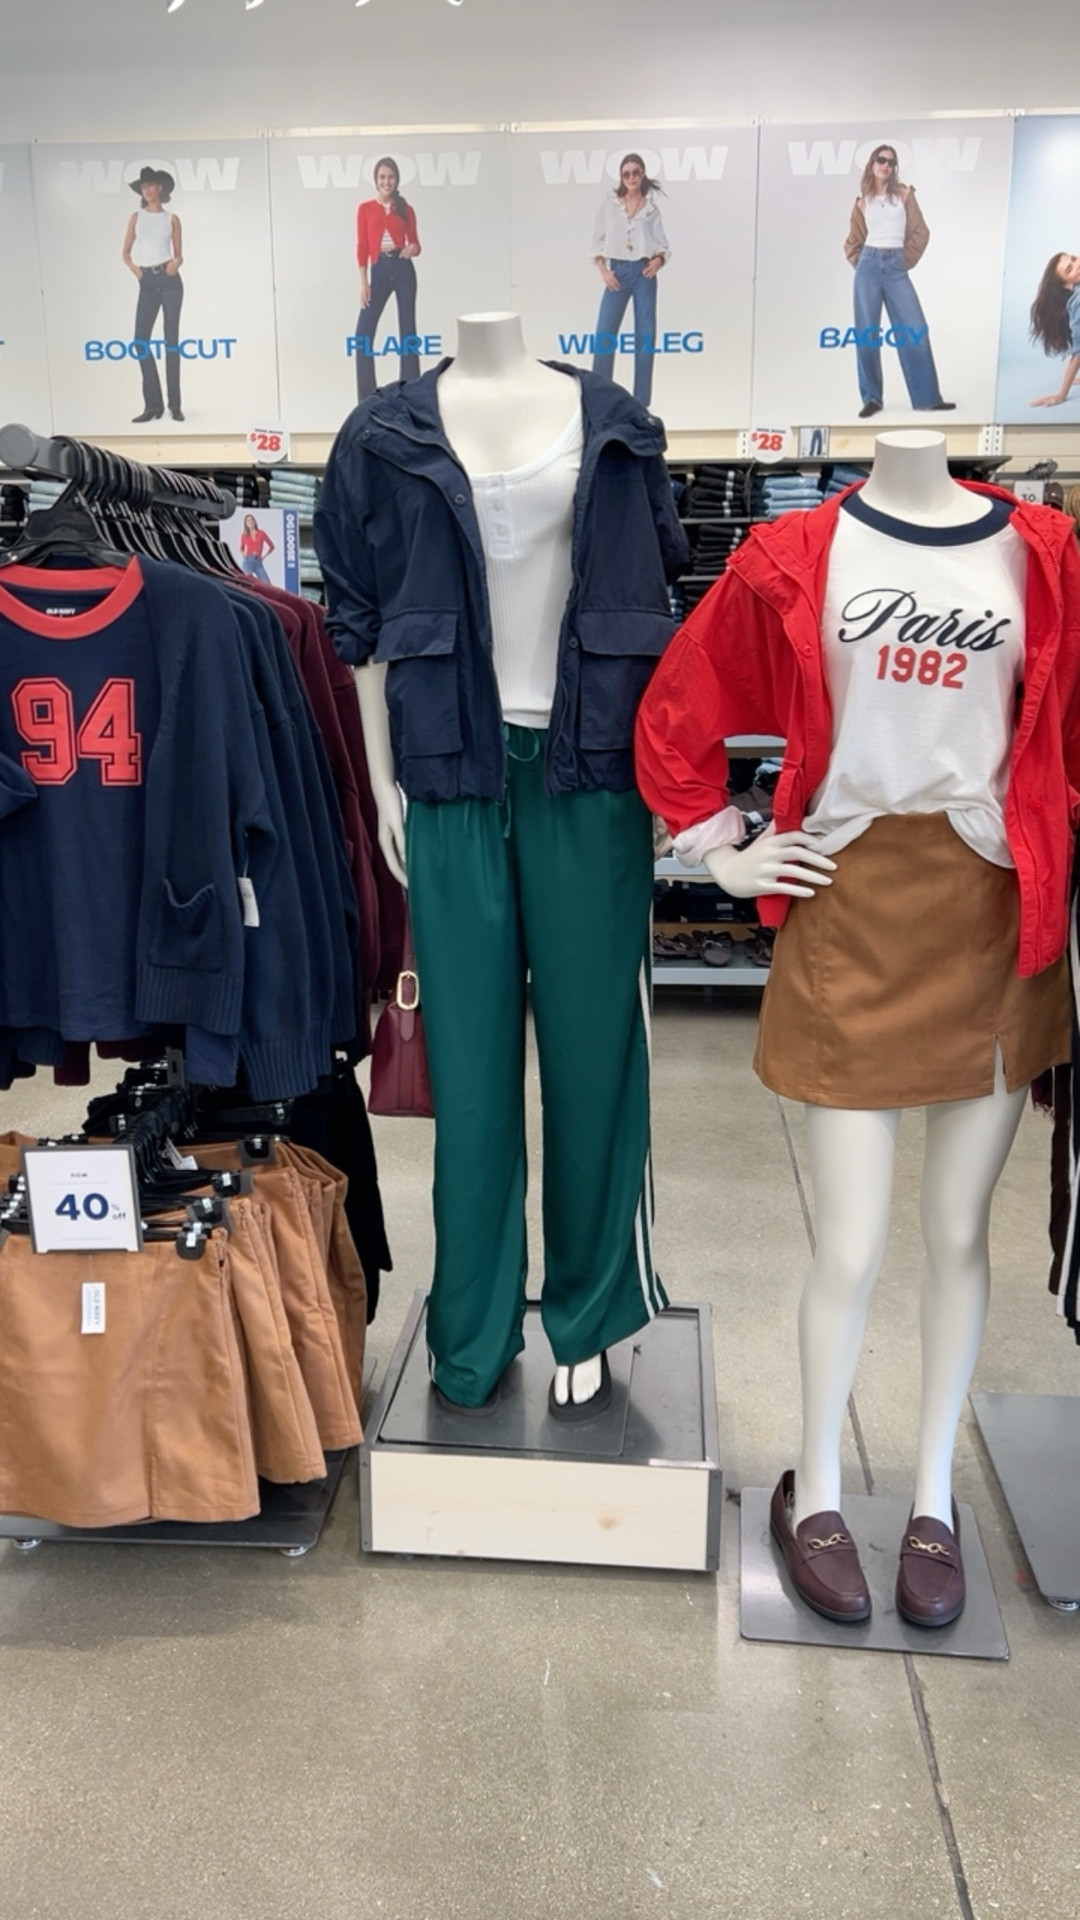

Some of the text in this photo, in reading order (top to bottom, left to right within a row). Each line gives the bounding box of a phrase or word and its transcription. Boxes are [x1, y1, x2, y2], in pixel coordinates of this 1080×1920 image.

[297, 152, 482, 189] WOW
[539, 146, 729, 185] WOW
[787, 137, 983, 176] WOW
[60, 157, 240, 193] WOW
[84, 338, 237, 361] BOOT-CUT
[345, 335, 442, 357] FLARE
[558, 331, 704, 355] WIDE LEG
[819, 325, 929, 349] BAGGY
[250, 433, 281, 451] $28
[751, 432, 783, 451] $28
[838, 588, 1012, 652] Paris
[876, 645, 968, 690] 1982
[11, 677, 142, 786] 94
[55, 1193, 109, 1221] 40
[112, 1213, 127, 1221] off
